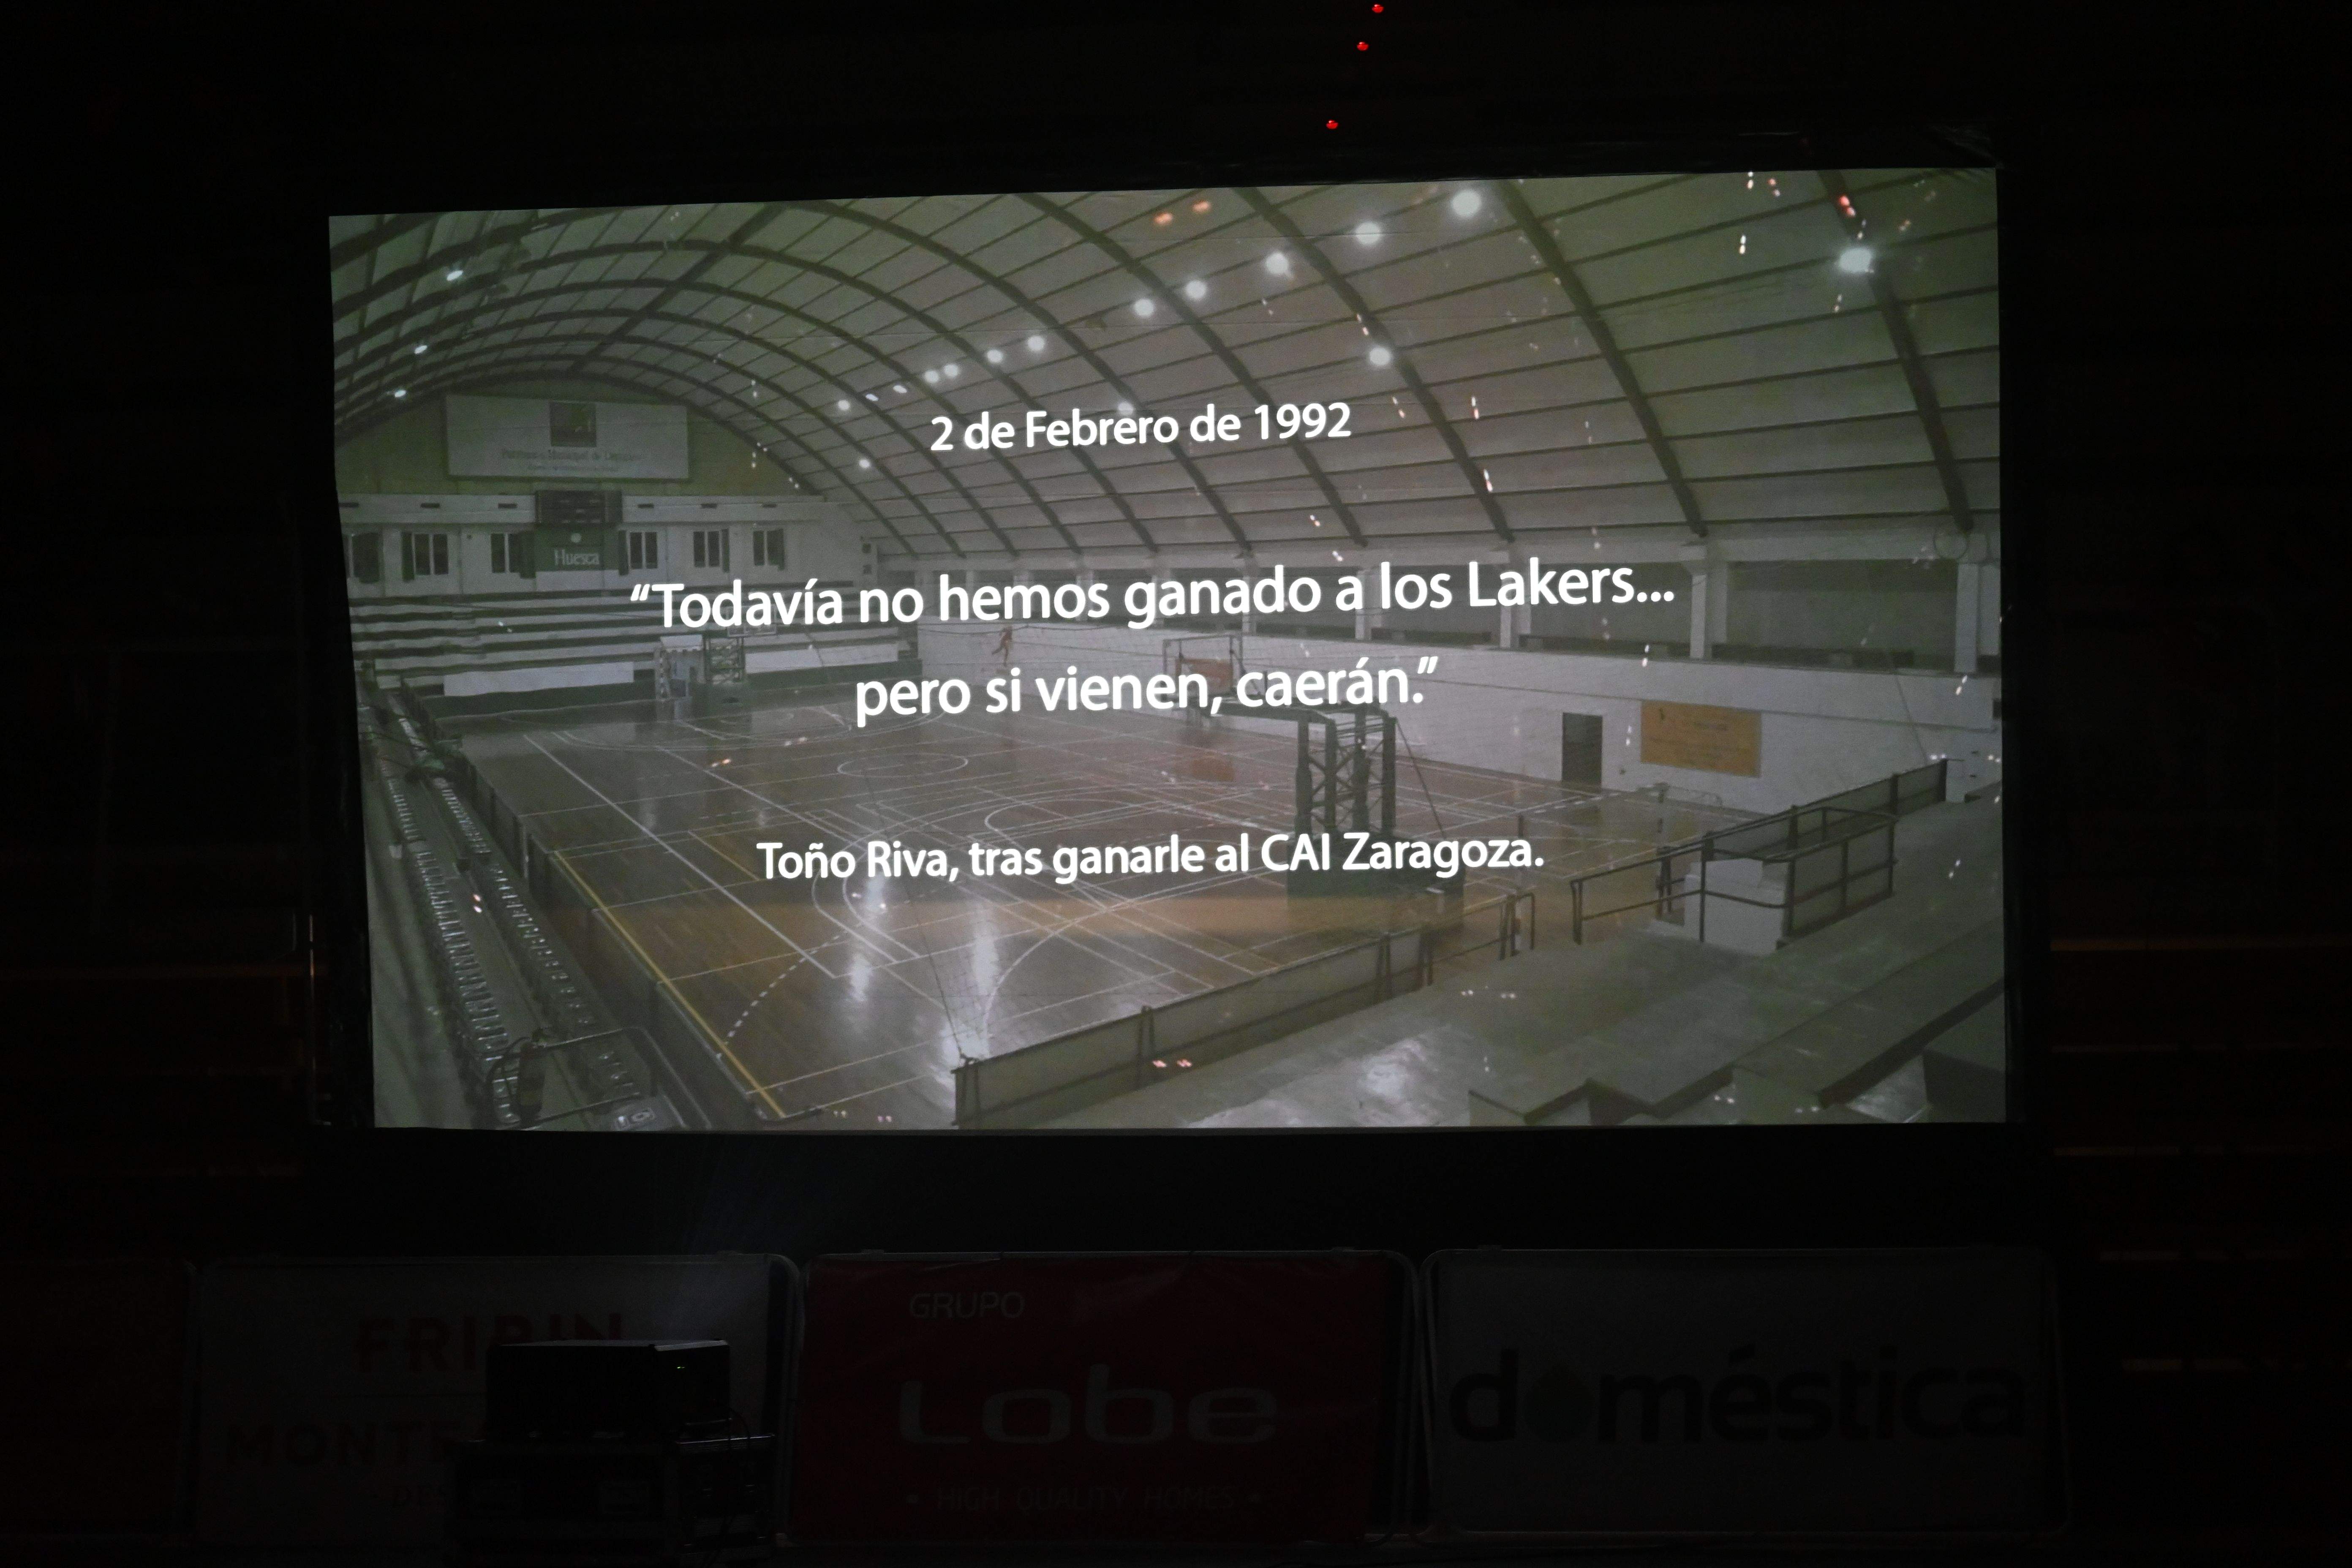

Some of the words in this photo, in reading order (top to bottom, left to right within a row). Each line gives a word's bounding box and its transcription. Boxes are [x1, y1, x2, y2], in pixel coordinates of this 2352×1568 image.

[931, 416, 953, 451] 2
[964, 411, 1015, 449] de
[1026, 408, 1179, 447] Febrero
[1190, 403, 1241, 442] de
[1255, 402, 1351, 440] 1992
[554, 548, 600, 566] Huesca
[630, 578, 843, 628] “Todavía
[860, 588, 923, 623] no
[940, 574, 1110, 621] hemos
[1124, 564, 1321, 629] ganado
[1336, 576, 1363, 611] a
[1381, 561, 1452, 609] los
[1469, 557, 1674, 607] Lakers...
[857, 679, 971, 727] pero
[986, 667, 1021, 713] si
[1035, 665, 1222, 715] vienen,
[1236, 656, 1438, 707] caerán.”
[756, 842, 856, 879] Toño
[868, 841, 959, 882] Riva,
[968, 842, 1043, 876] tras
[1053, 834, 1205, 885] ganarle
[1215, 833, 1249, 872] al
[1261, 833, 1330, 871] CAI
[1342, 832, 1544, 878] Zaragoza.
[909, 1290, 1026, 1320] GRUPO
[900, 1363, 1279, 1446] Lobe
[936, 1486, 1000, 1511] HIGH
[1016, 1485, 1129, 1516] QUALITY
[1144, 1485, 1236, 1511] HOMES
